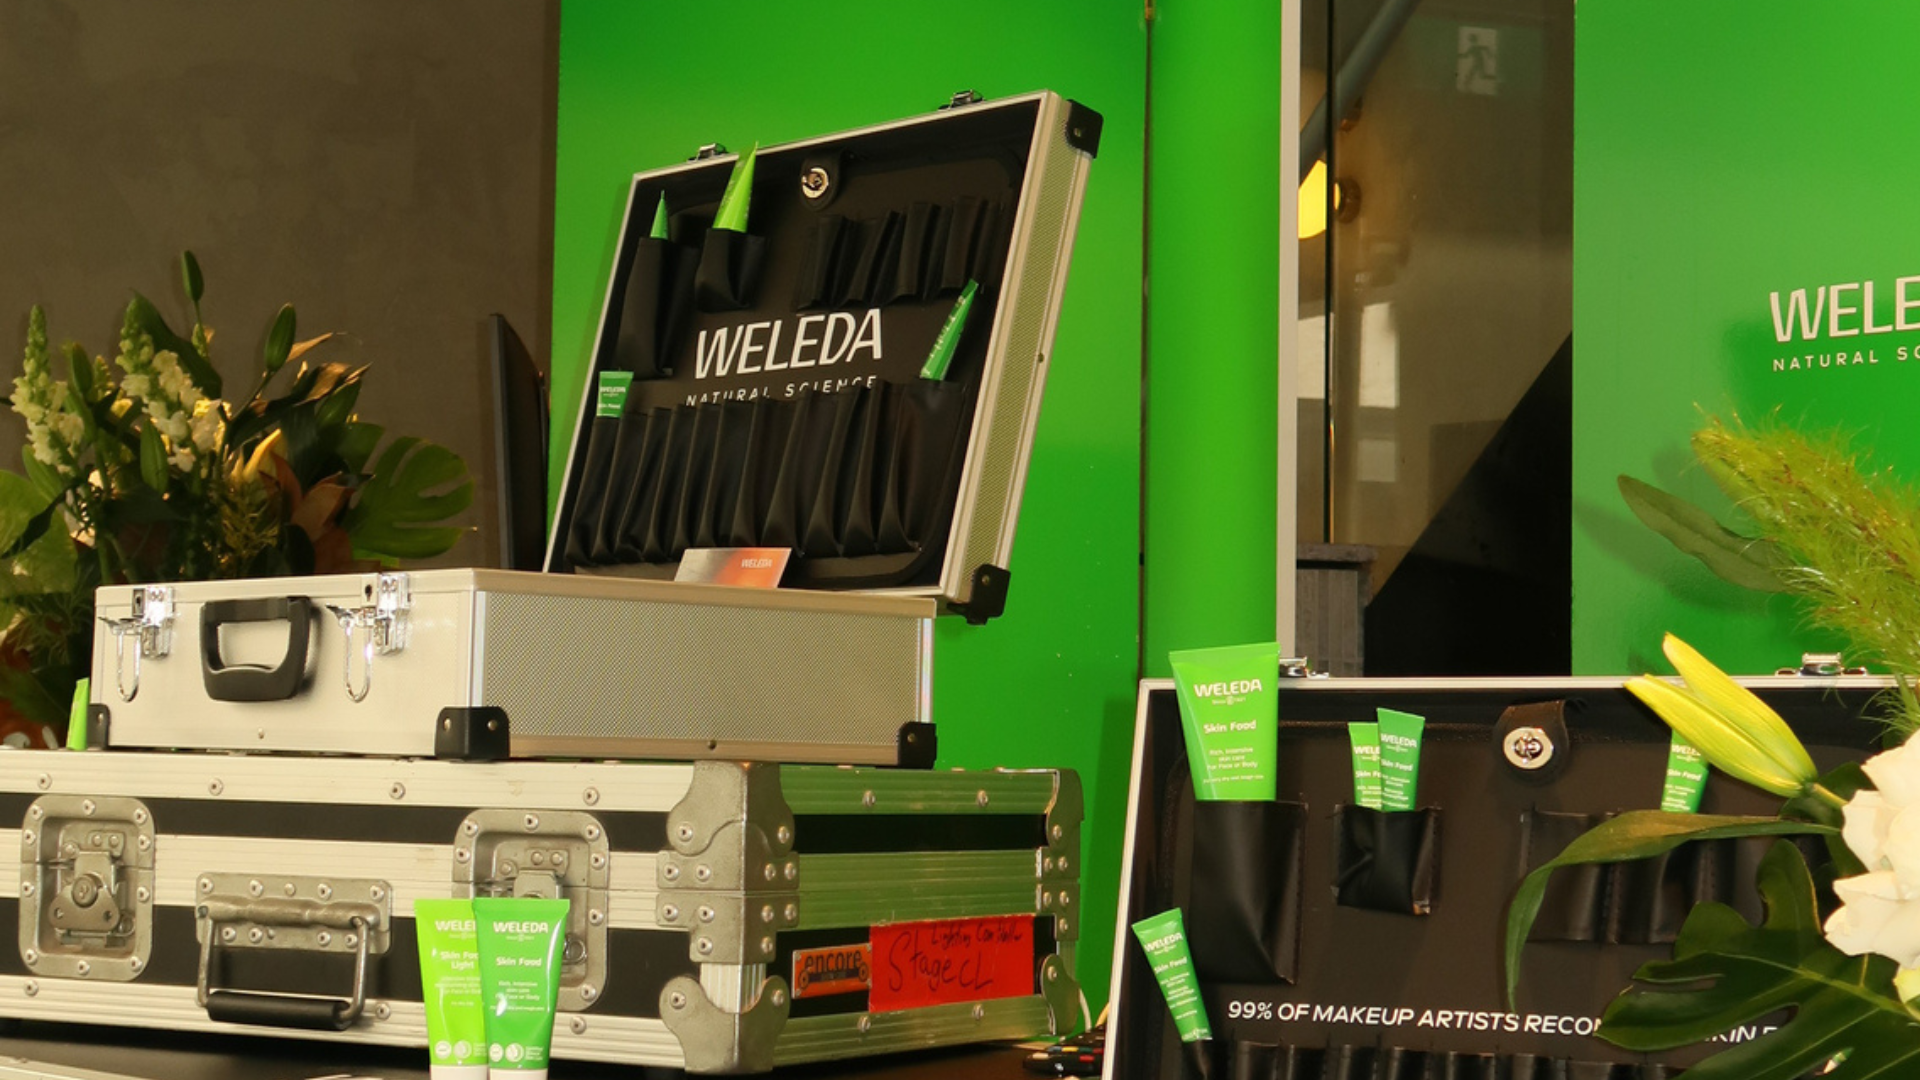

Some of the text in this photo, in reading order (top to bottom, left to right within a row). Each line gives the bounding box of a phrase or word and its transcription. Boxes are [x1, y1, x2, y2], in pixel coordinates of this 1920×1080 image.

[695, 308, 882, 379] WELEDA
[1772, 350, 1879, 372] NATURAL
[1193, 679, 1263, 697] WELEDA
[1203, 719, 1257, 734] Skin Food
[1380, 733, 1417, 748] WELEDA
[493, 921, 549, 933] WELEDA
[1144, 932, 1183, 952] WELEDA
[440, 951, 460, 960] Skin
[496, 957, 542, 967] Skin Food
[804, 949, 862, 974] encore
[451, 961, 475, 971] Light
[1228, 1001, 1273, 1020] 99%
[1277, 1003, 1310, 1021] OF
[1312, 1005, 1415, 1026] MAKEUP
[1417, 1009, 1519, 1032] ARTISTS
